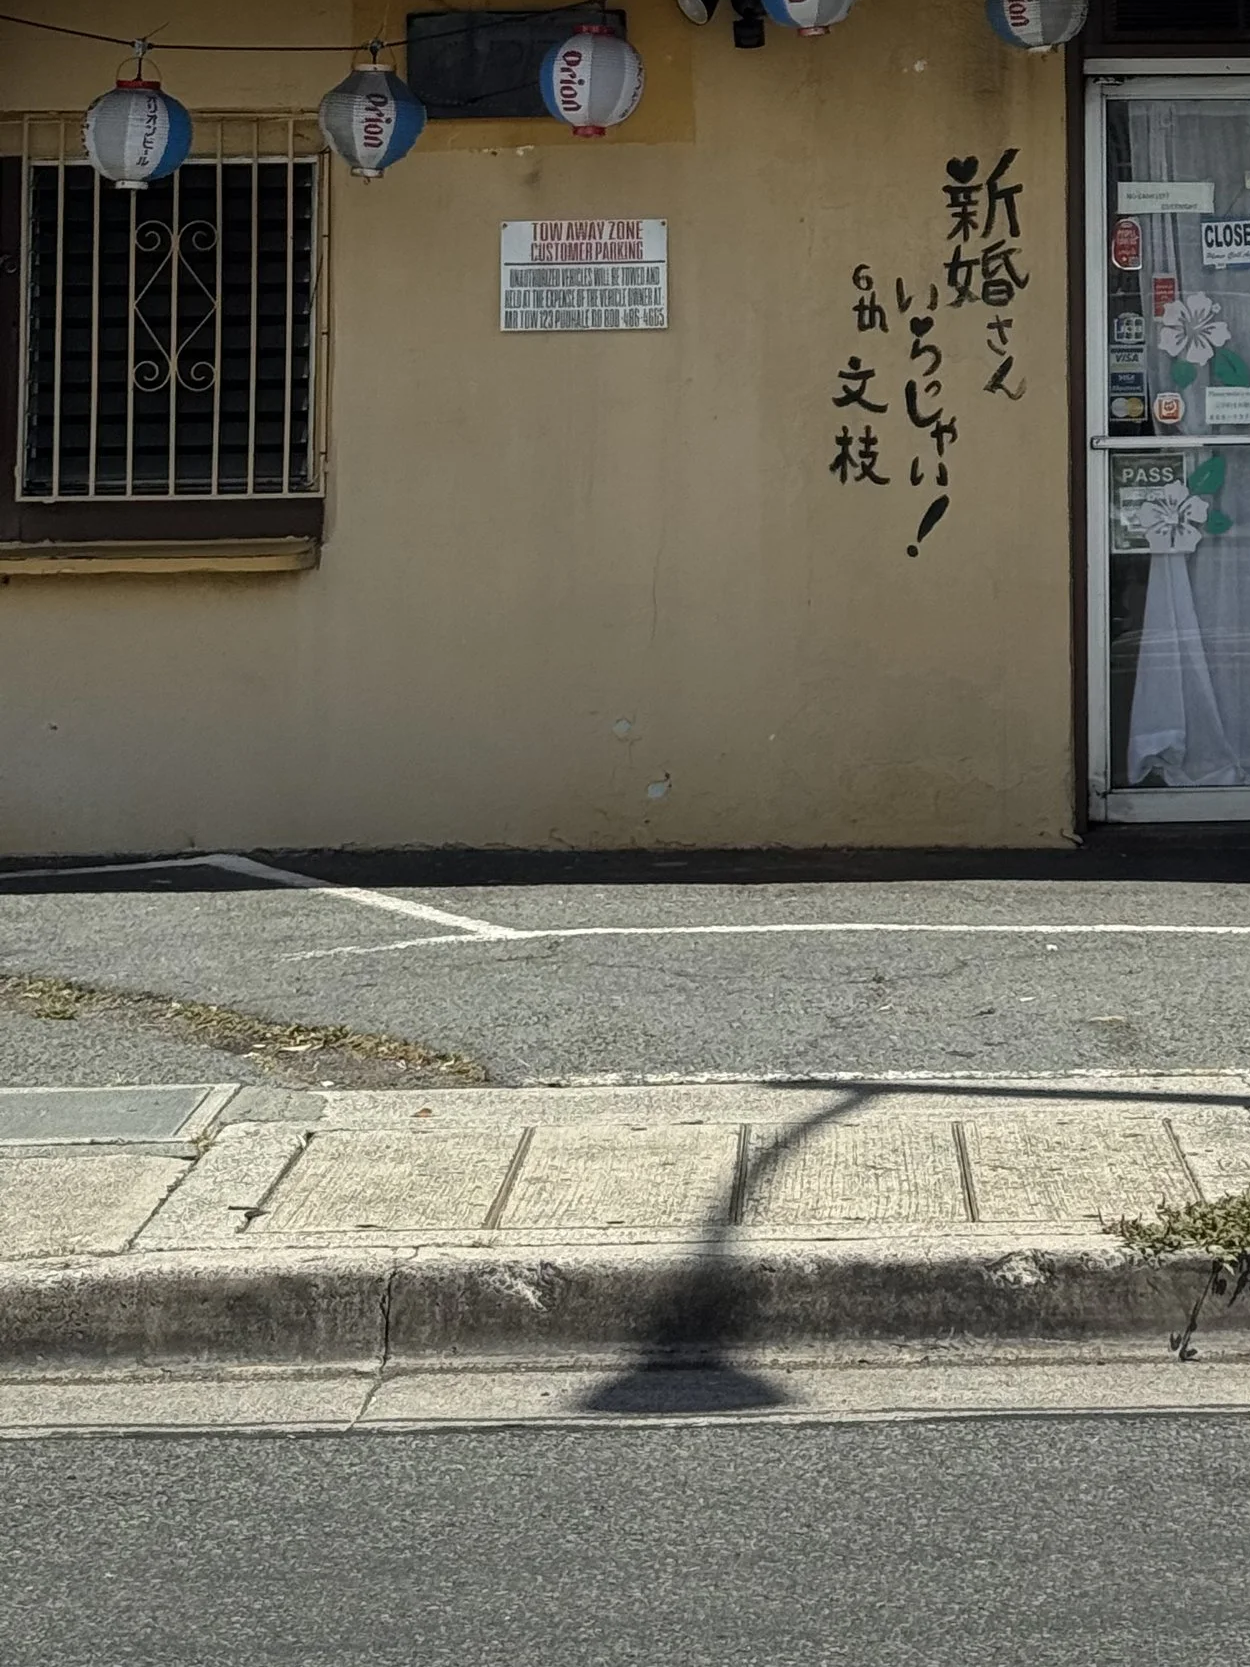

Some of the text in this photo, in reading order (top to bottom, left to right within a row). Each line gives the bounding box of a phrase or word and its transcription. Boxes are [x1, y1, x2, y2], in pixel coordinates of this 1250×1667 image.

[559, 50, 586, 112] Orion
[362, 93, 394, 149] Orion
[532, 220, 644, 242] TOW AWAY ZONE
[530, 241, 644, 262] CUSTOMER PARKING
[621, 266, 645, 286] TOWED
[646, 265, 660, 286] AND
[941, 147, 1030, 401] 新婚さん
[851, 263, 890, 334] 6th
[504, 310, 518, 329] MR
[519, 310, 539, 329] TOW
[539, 310, 554, 329] 123
[1115, 353, 1139, 363] VISA
[828, 355, 891, 487] 文枝
[1121, 466, 1175, 483] PASS
